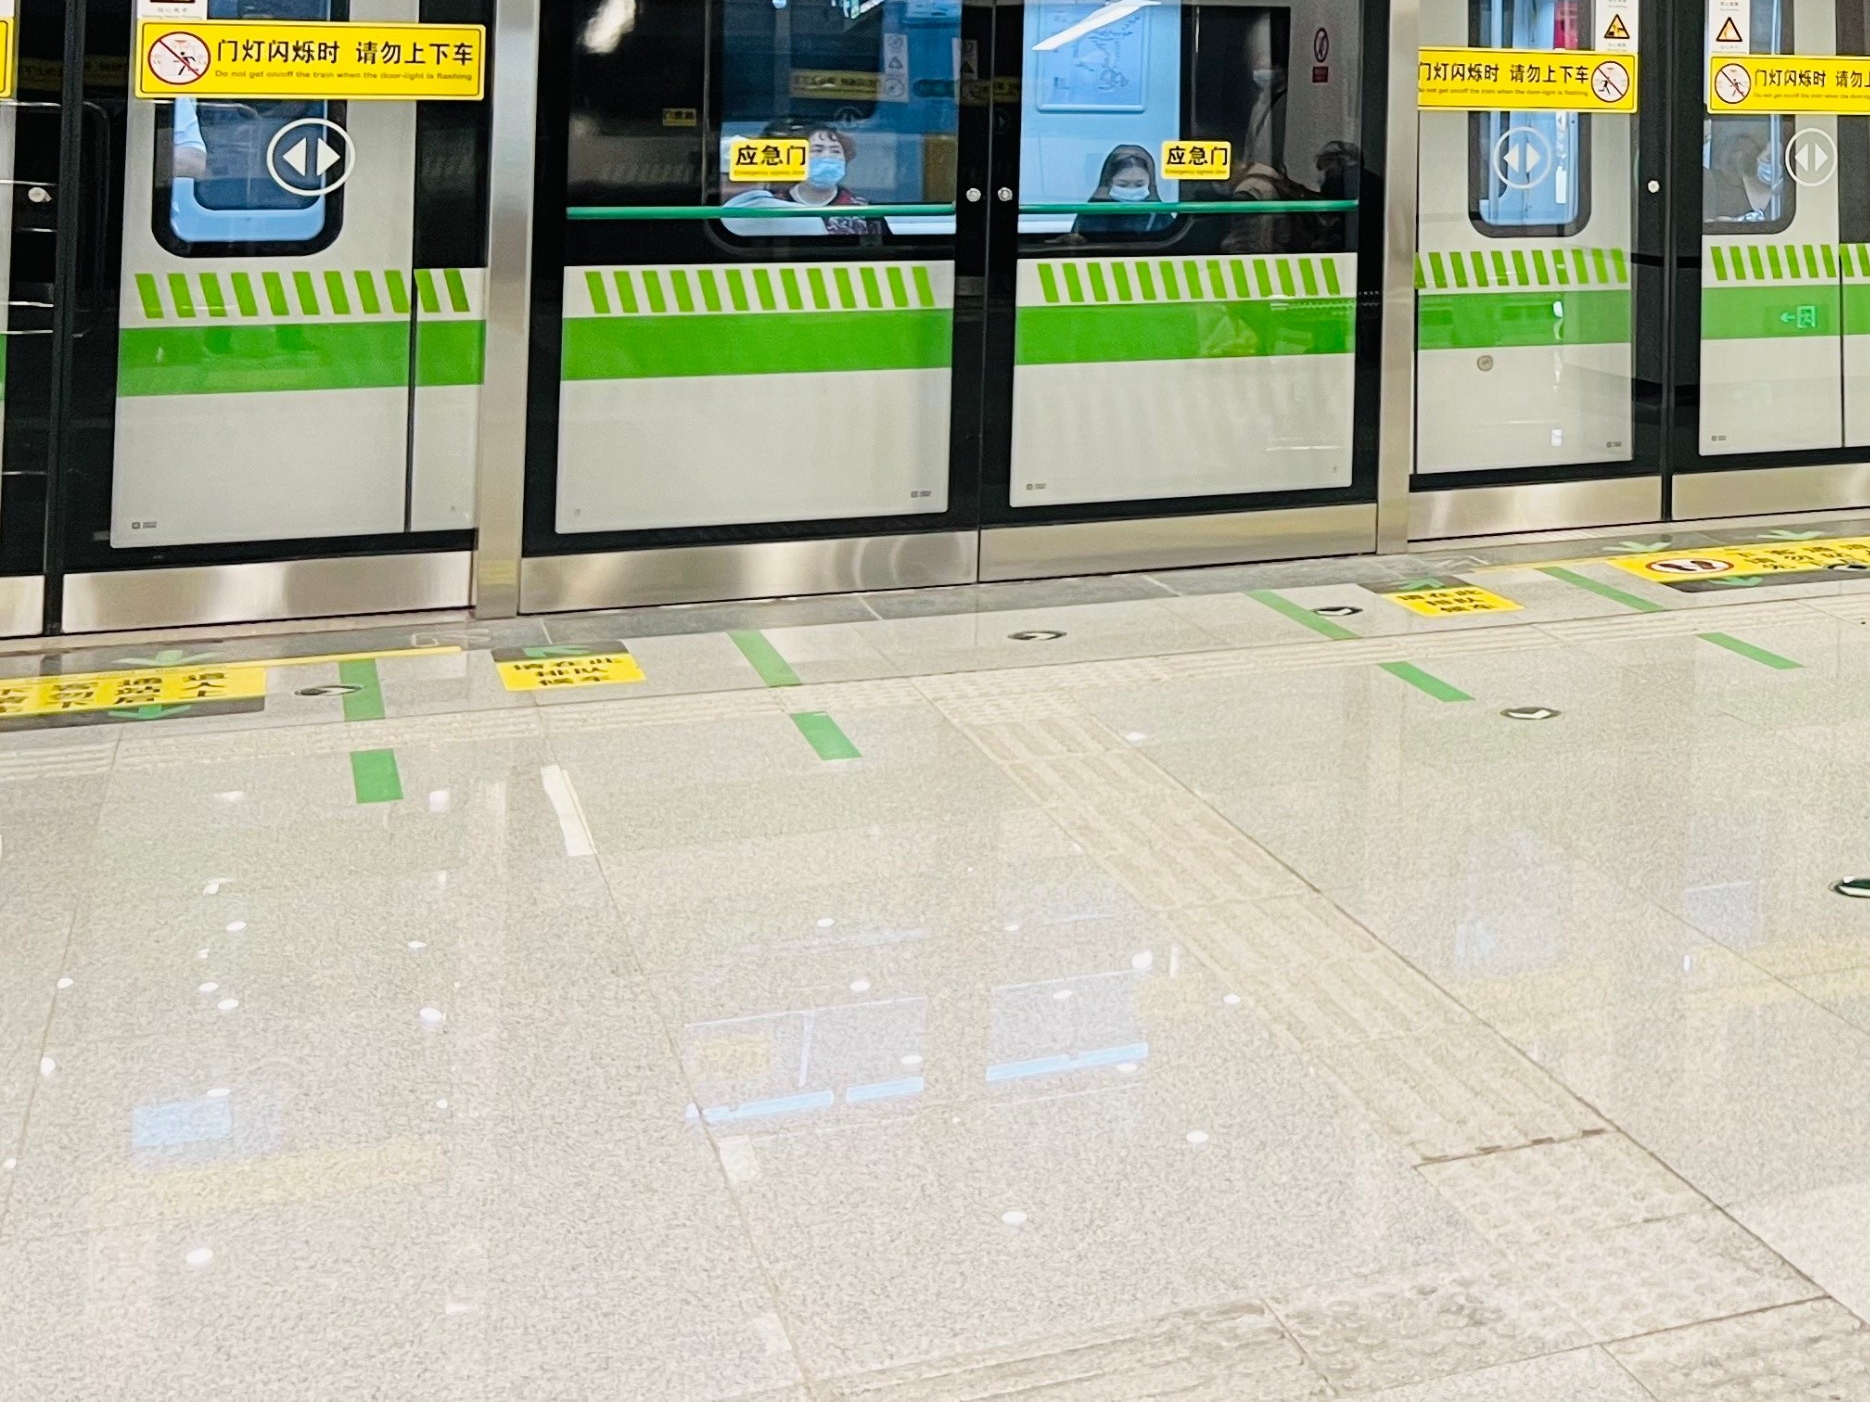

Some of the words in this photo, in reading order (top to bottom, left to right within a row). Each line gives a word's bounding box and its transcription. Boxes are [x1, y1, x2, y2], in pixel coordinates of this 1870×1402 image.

[217, 39, 341, 64] 门灯闪烁时
[356, 41, 474, 66] 请勿上下车
[1418, 62, 1499, 83] 门灯闪烁时
[1509, 64, 1589, 84] 请勿上下车
[1754, 69, 1827, 88] 门灯闪烁时
[735, 145, 806, 166] 应急门
[1166, 145, 1228, 166] 应急门
